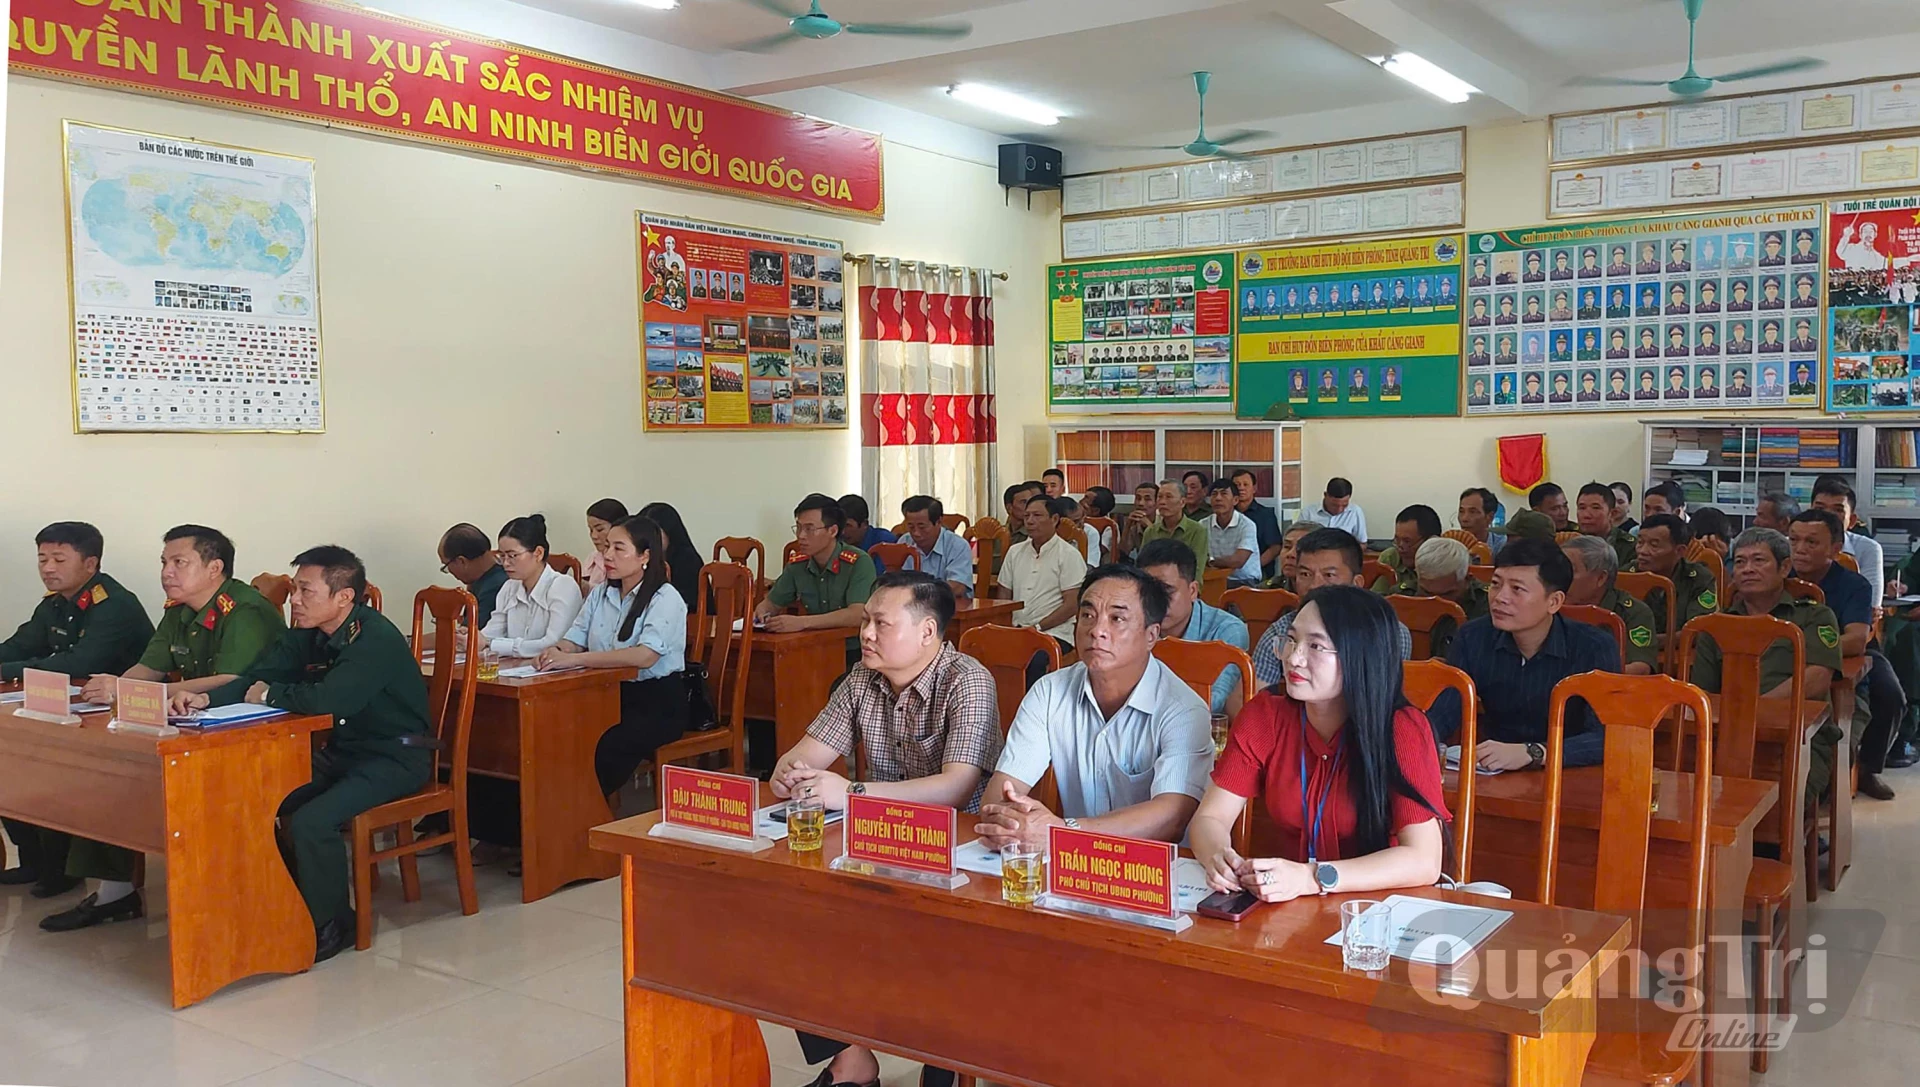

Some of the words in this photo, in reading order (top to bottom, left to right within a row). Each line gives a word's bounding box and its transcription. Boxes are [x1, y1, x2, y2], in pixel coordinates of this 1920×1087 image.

[198, 0, 353, 60] THÀNH
[366, 35, 469, 84] XUẤT
[479, 54, 552, 101] SẮC
[562, 79, 658, 126] NHIỆM
[667, 103, 704, 140] VỤ
[177, 44, 300, 100] LÃNH
[314, 71, 411, 126] THỔ,
[424, 97, 478, 133] AN
[490, 108, 573, 150] NINH
[584, 126, 649, 164] BIÊN
[658, 142, 720, 177] GIỚI
[728, 156, 805, 192] QUỐC
[811, 174, 853, 201] GIA
[168, 145, 183, 157] CÁC
[184, 147, 204, 160] NƯỚC
[206, 151, 224, 163] TRÊN
[1862, 198, 1876, 210] TRẺ
[1878, 198, 1901, 209] QUÂN
[1903, 196, 1917, 209] ĐỘI
[1702, 217, 1732, 229] GIANH
[1733, 216, 1753, 228] QUA
[1754, 211, 1775, 224] CÁC
[1405, 335, 1425, 349] GIANH
[673, 787, 689, 809] ĐẬU
[691, 791, 717, 811] THÀNH
[719, 797, 747, 817] TRUNG
[854, 816, 890, 839] NGUYỄN
[893, 820, 913, 842] TIẾN
[916, 825, 947, 848] THÀNH
[899, 847, 911, 860] VIỆT
[911, 850, 924, 860] NAM
[1093, 840, 1113, 852] ĐỒNG
[1114, 844, 1126, 854] CHÍ
[1059, 848, 1088, 873] TRẦN
[1090, 856, 1121, 881] NGỌC
[1124, 862, 1163, 887] HƯƠNG
[1059, 874, 1074, 888] PHÓ
[1075, 877, 1090, 891] CHỦ
[1091, 881, 1109, 896] TỊCH
[1110, 884, 1131, 898] UBND
[1132, 887, 1164, 905] PHƯỜNG
